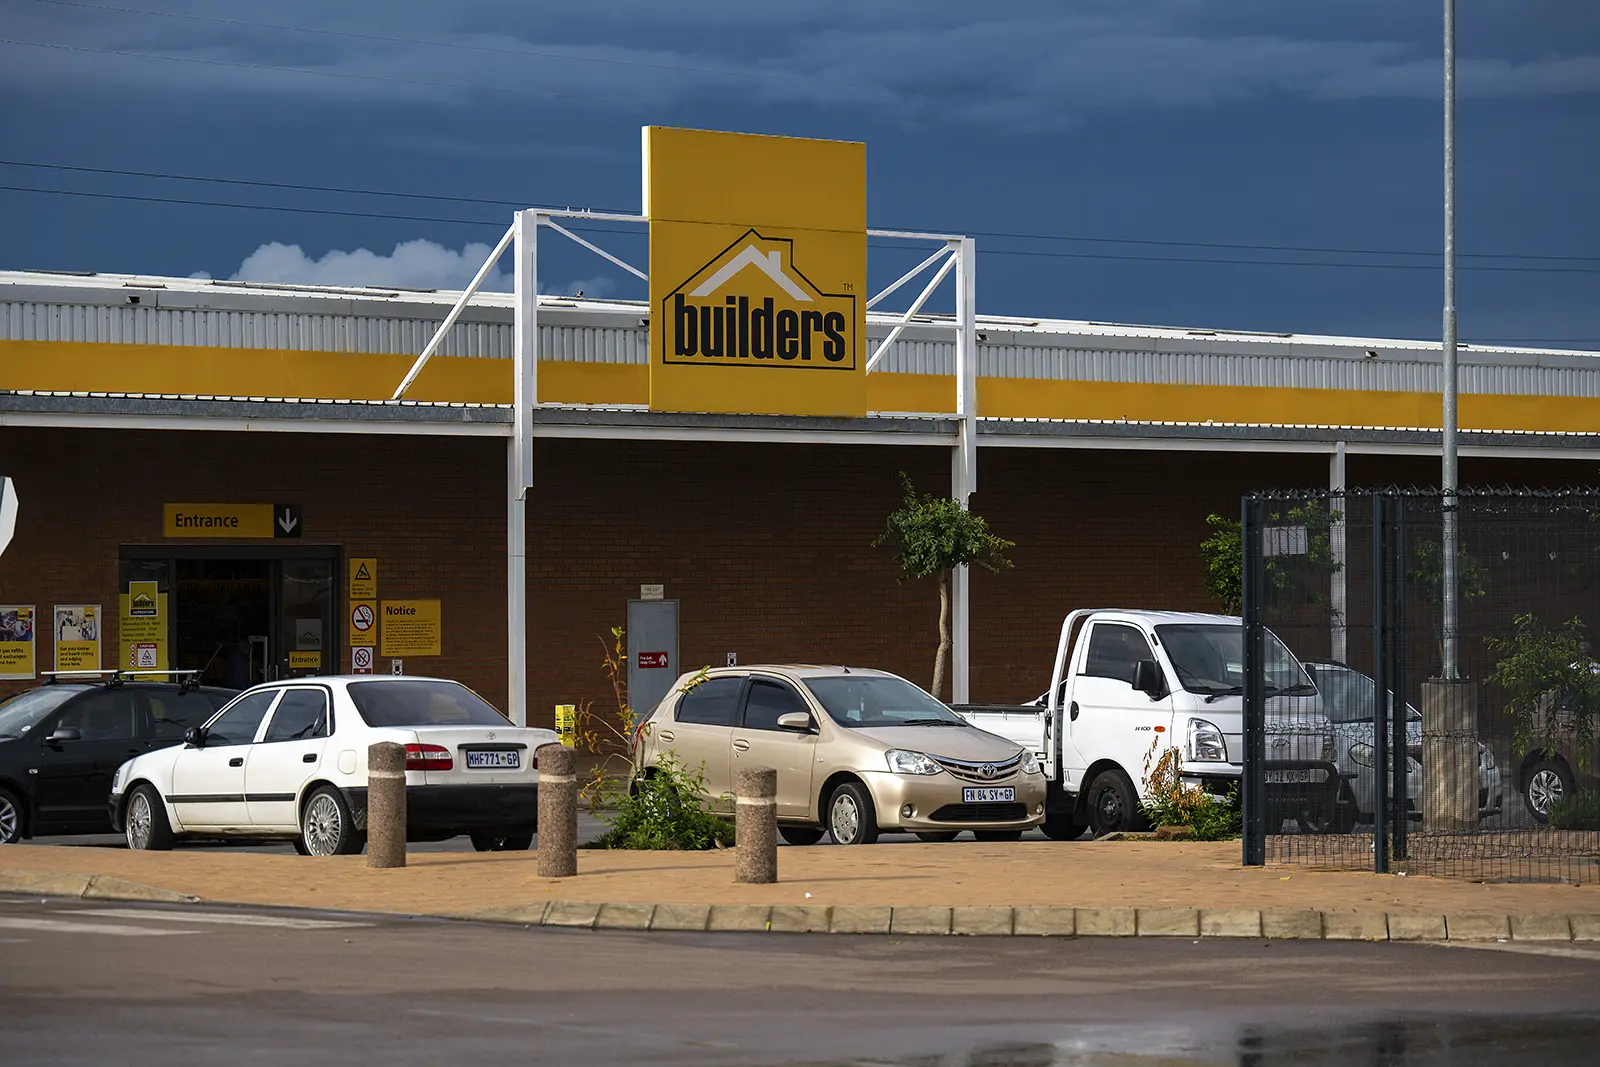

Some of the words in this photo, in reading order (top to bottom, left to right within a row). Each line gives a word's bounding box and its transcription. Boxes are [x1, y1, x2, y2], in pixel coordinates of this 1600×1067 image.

[674, 293, 846, 362] builders
[175, 513, 239, 527] Entrance
[133, 599, 155, 607] builders
[386, 605, 416, 615] Notice
[507, 753, 517, 765] GP
[965, 789, 975, 801] FN
[977, 789, 987, 801] 84
[989, 789, 999, 800] SY
[1004, 789, 1013, 800] GP
